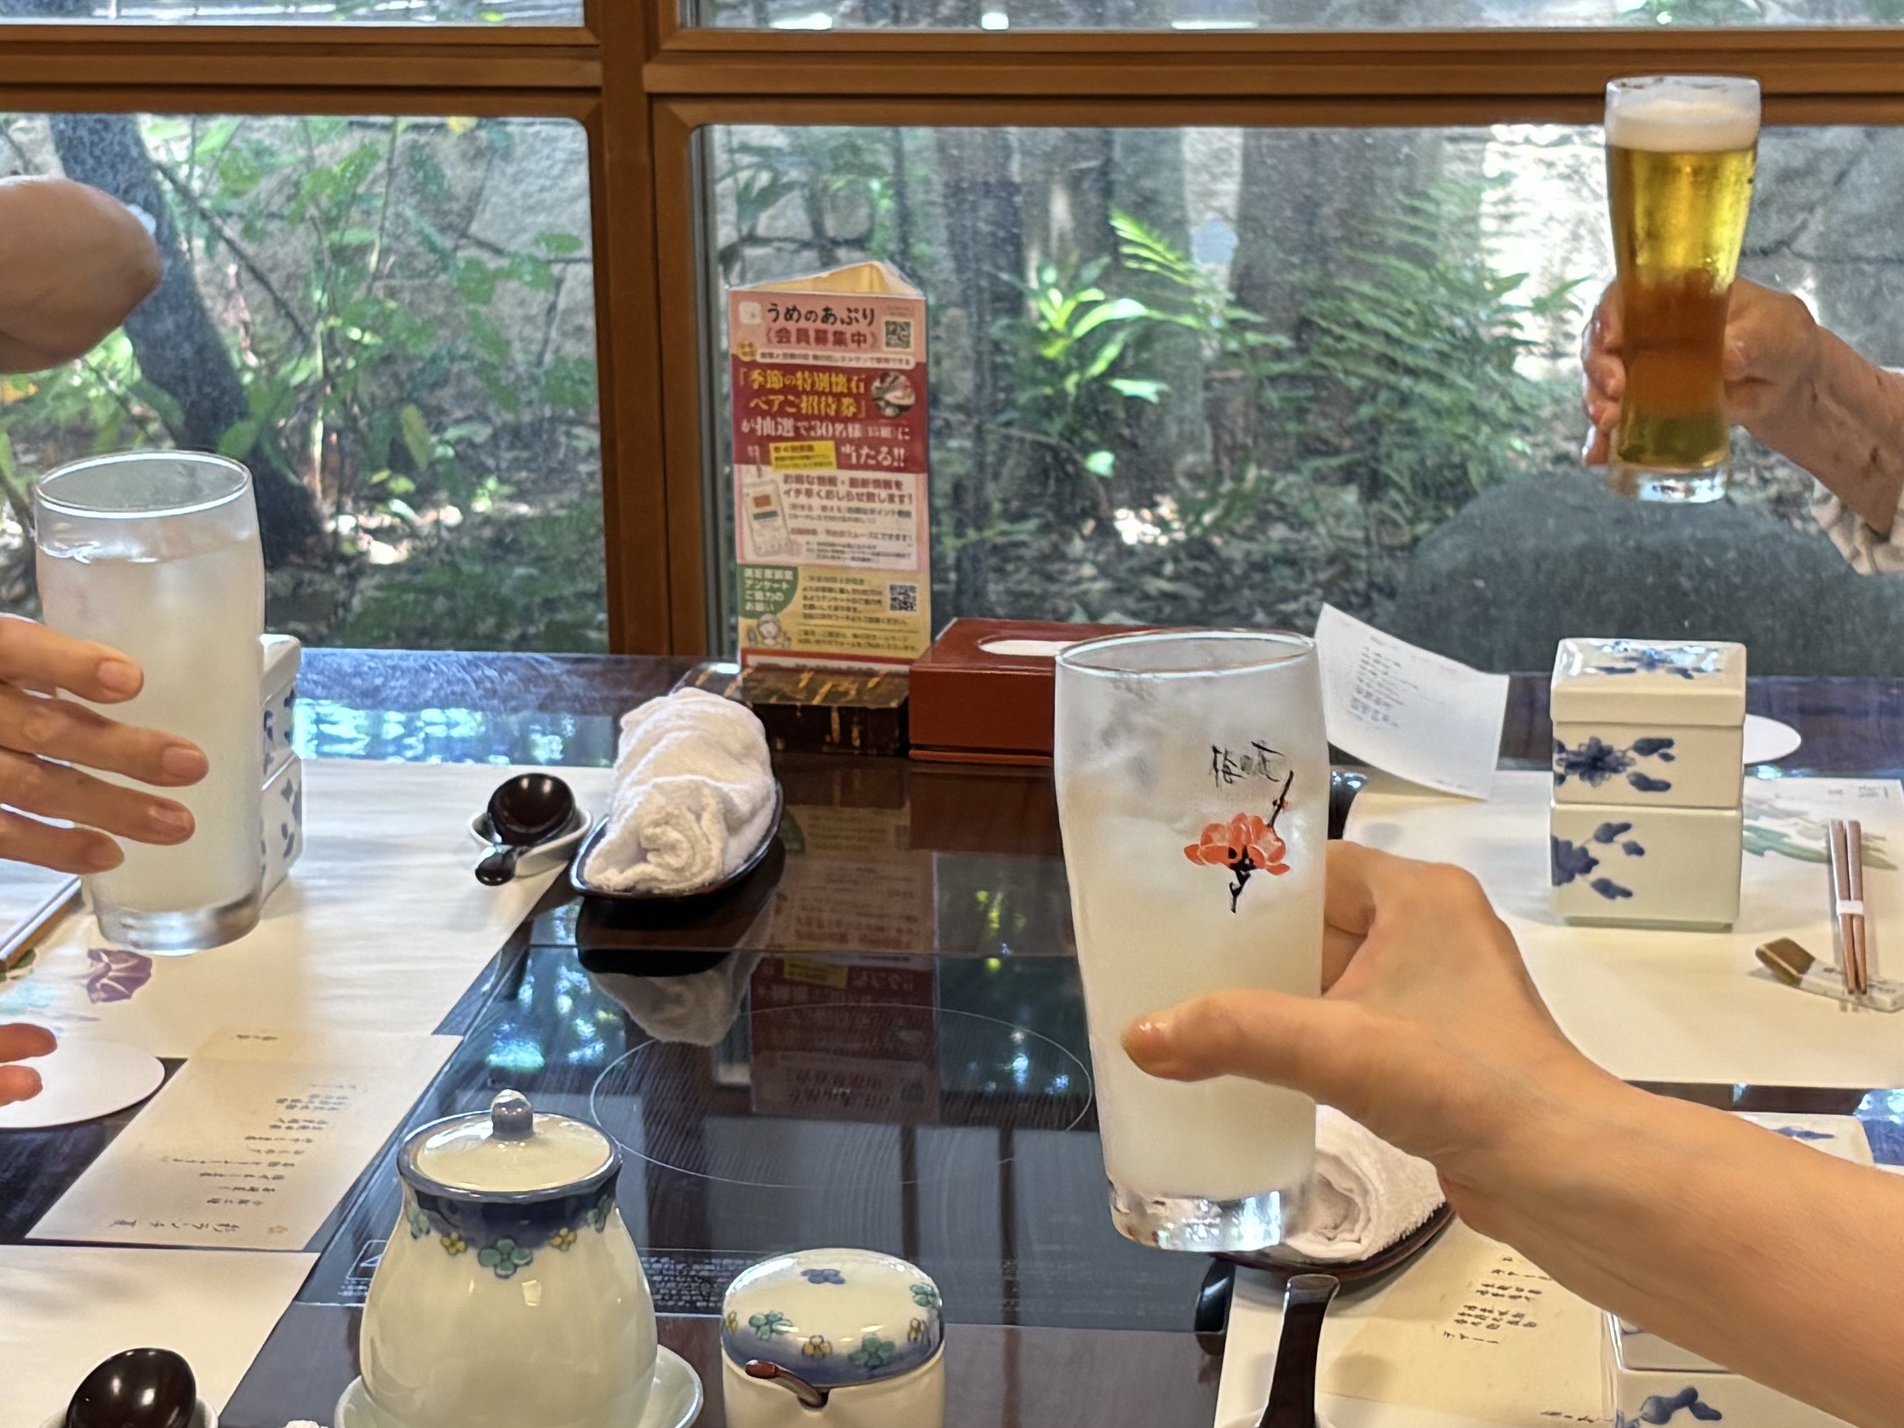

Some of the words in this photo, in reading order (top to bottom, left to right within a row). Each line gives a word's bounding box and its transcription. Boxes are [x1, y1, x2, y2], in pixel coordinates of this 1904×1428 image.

[766, 302, 876, 326] うめのあぷり
[739, 368, 866, 394] 「季節の特別懐石
